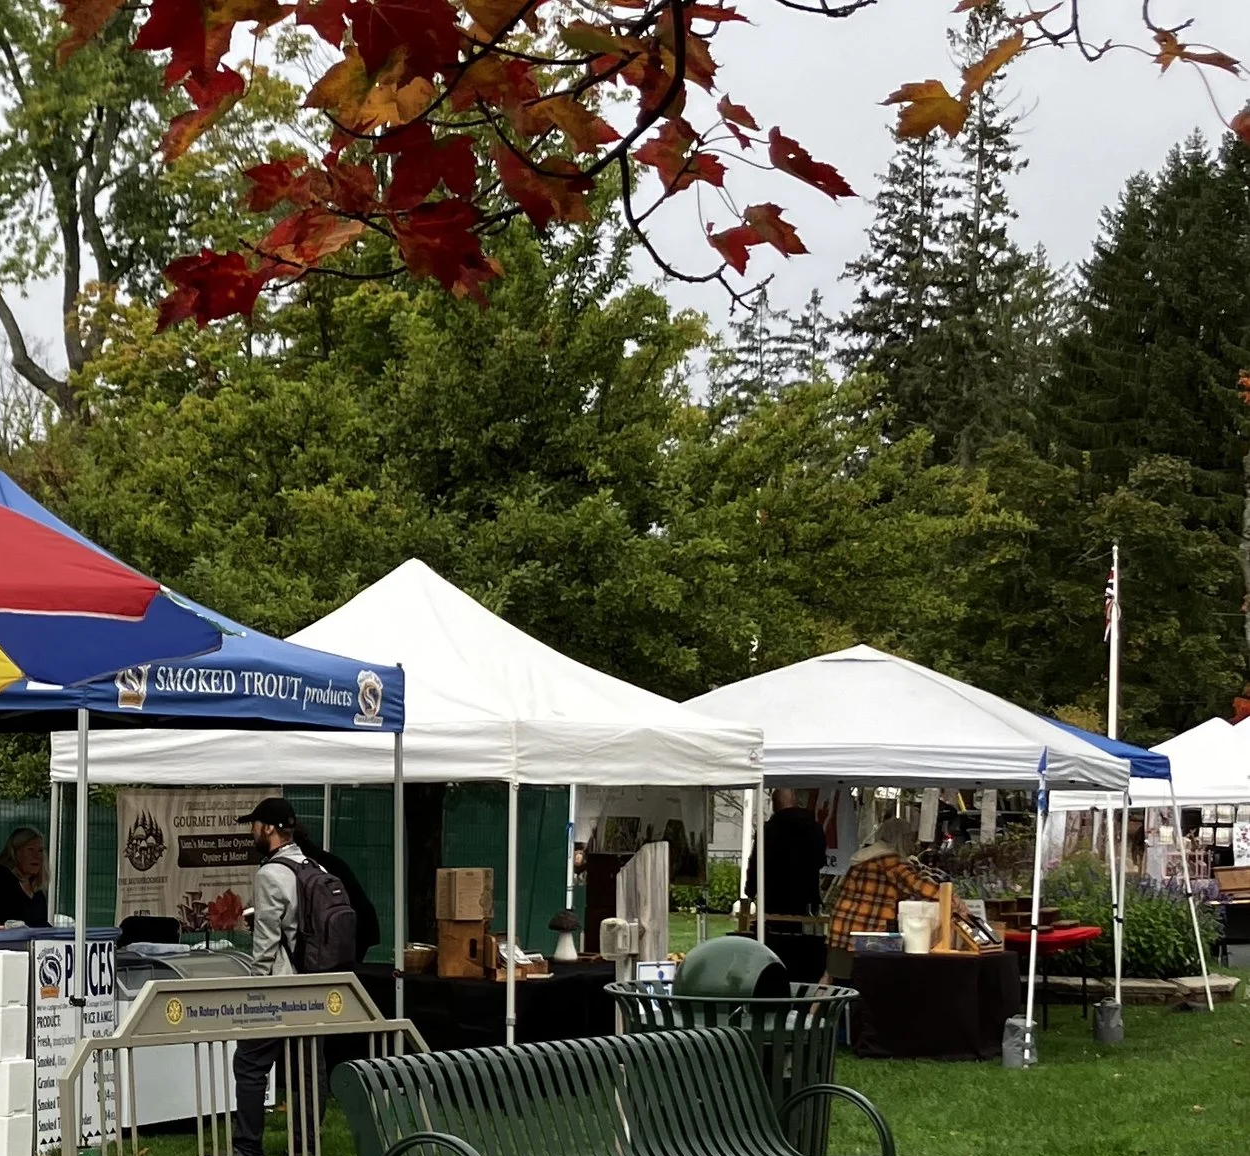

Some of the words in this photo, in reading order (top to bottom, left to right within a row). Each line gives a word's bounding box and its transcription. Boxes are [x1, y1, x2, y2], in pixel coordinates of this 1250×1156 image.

[155, 666, 236, 695] SMOKED
[239, 671, 302, 700] TROUT
[302, 679, 353, 711] products
[173, 815, 217, 828] GOURMET
[202, 852, 222, 864] Oyster
[223, 852, 229, 861] &
[65, 942, 114, 997] PICES
[186, 1007, 198, 1018] The
[199, 1005, 219, 1018] Rotary
[220, 1004, 235, 1016] Club
[235, 1004, 243, 1015] of
[308, 1000, 325, 1012] Lakes
[37, 1099, 56, 1112] Smoked
[38, 1118, 57, 1132] Smoked
